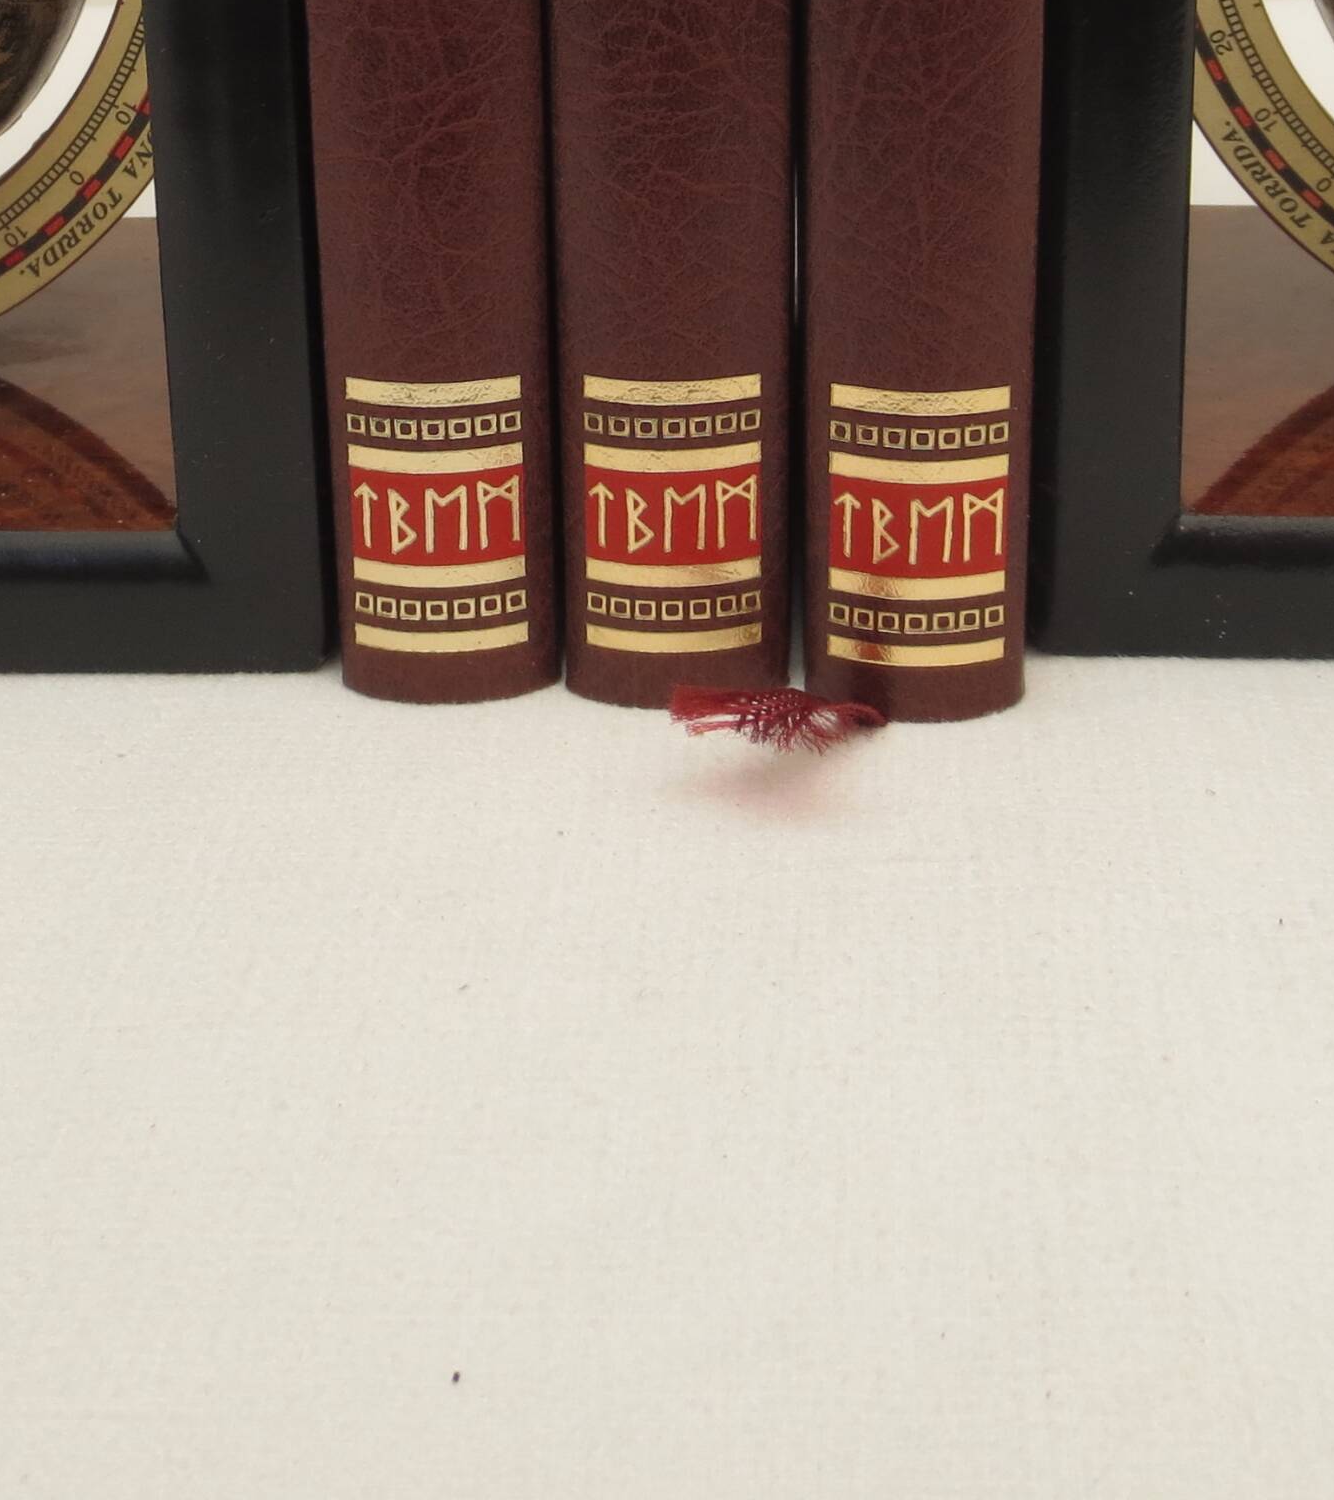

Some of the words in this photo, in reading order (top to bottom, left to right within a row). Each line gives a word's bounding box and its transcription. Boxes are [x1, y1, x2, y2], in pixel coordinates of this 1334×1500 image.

[1211, 29, 1233, 55] 20
[115, 100, 139, 126] 10
[1254, 107, 1277, 133] 10
[69, 170, 85, 187] 0
[1219, 120, 1312, 230] TORRIDA.
[1316, 176, 1332, 192] 0
[4, 225, 29, 248] 10
[19, 189, 124, 281] TORRIDA.
